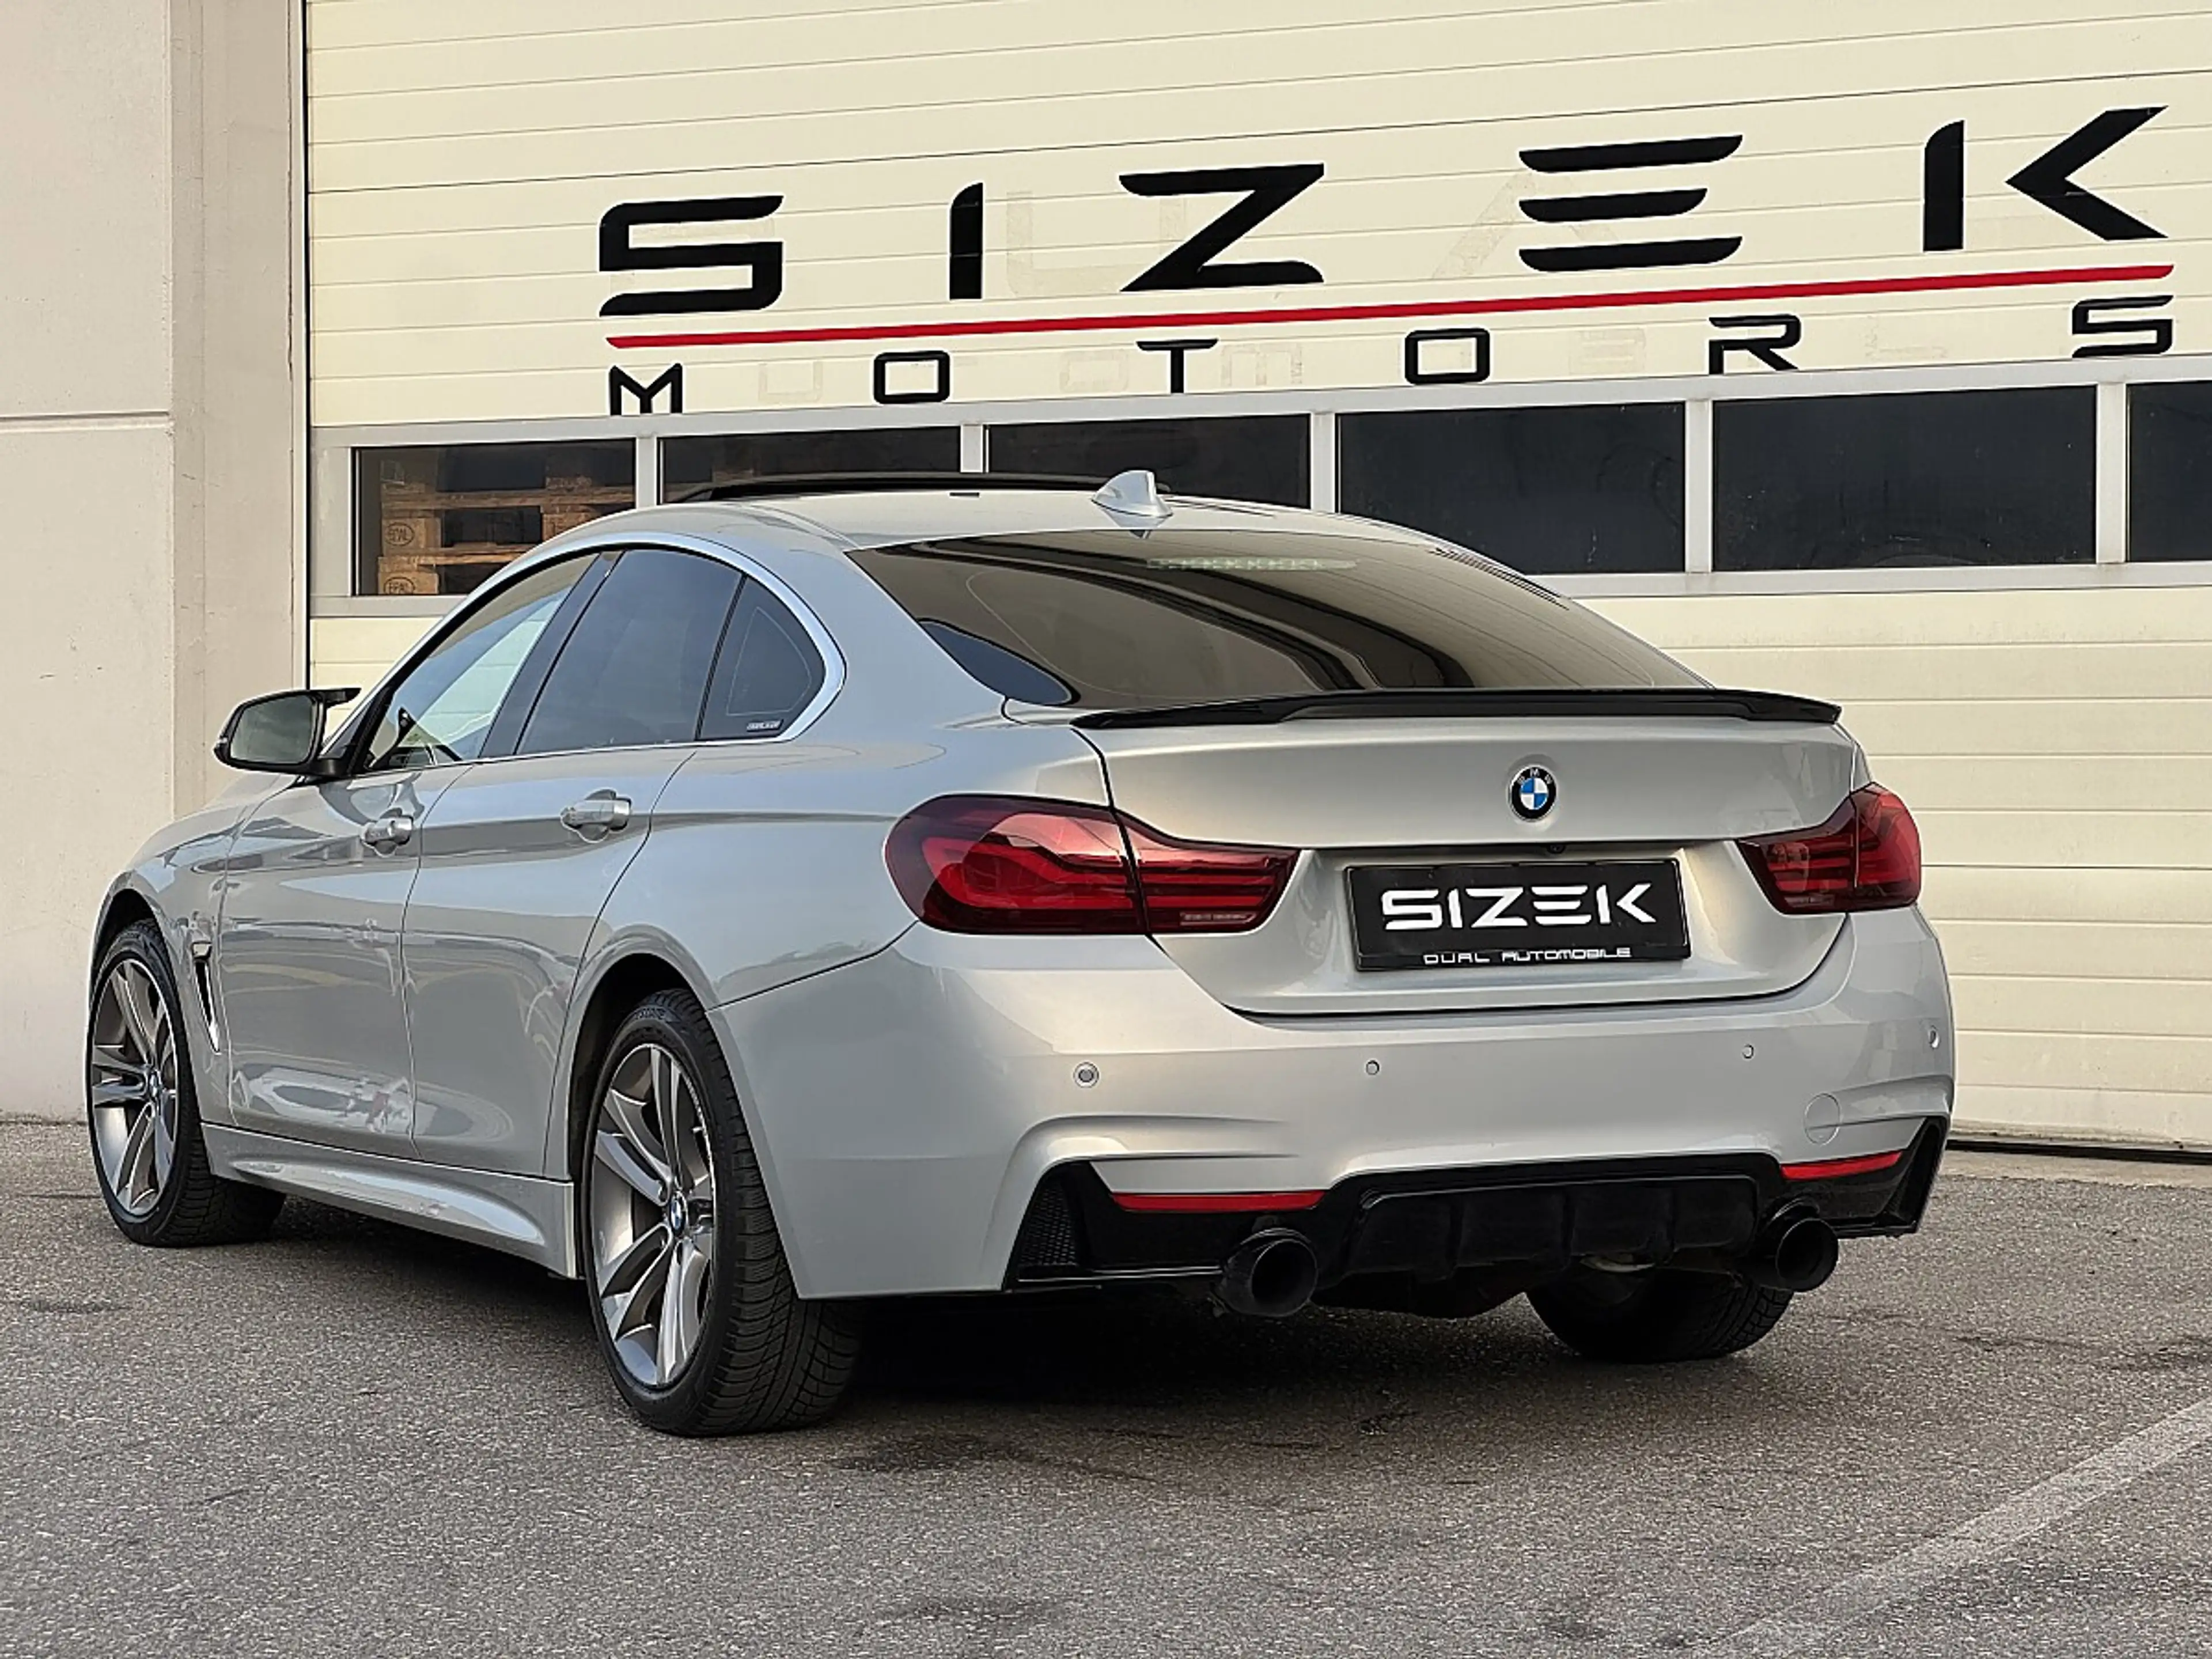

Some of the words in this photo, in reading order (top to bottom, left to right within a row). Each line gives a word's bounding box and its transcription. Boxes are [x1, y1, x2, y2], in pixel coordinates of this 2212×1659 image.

[598, 106, 2168, 317] SIZEK
[608, 294, 2174, 416] MOTORS
[1517, 767, 1554, 785] BMW
[1380, 882, 1657, 931] SIZEK
[1423, 952, 1491, 965] DUAL
[1501, 946, 1632, 963] AUTOMOBILE
